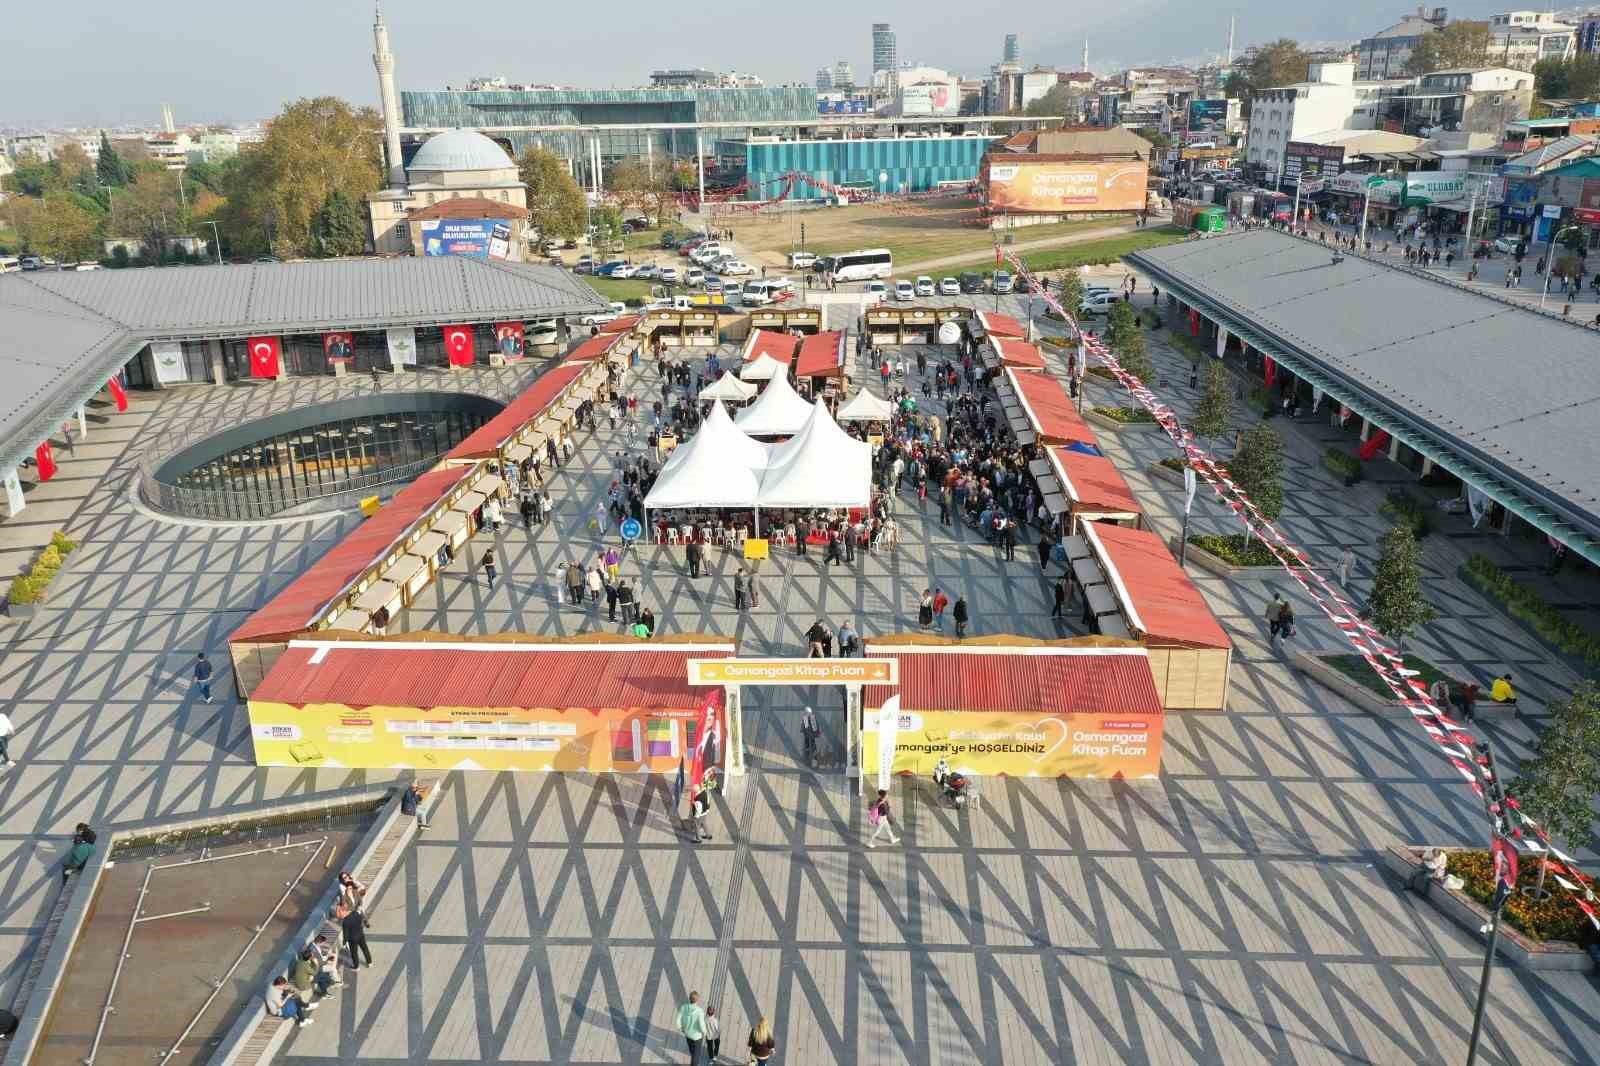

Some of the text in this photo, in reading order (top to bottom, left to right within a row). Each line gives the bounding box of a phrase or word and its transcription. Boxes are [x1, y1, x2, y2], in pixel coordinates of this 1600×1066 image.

[724, 665, 793, 678] Osmangazi
[796, 664, 830, 678] Kitap
[1073, 731, 1147, 744] Osmangazi
[894, 742, 1046, 755] smangazi'ye HOŞGELDİNİZ
[1073, 744, 1108, 757] Kitap
